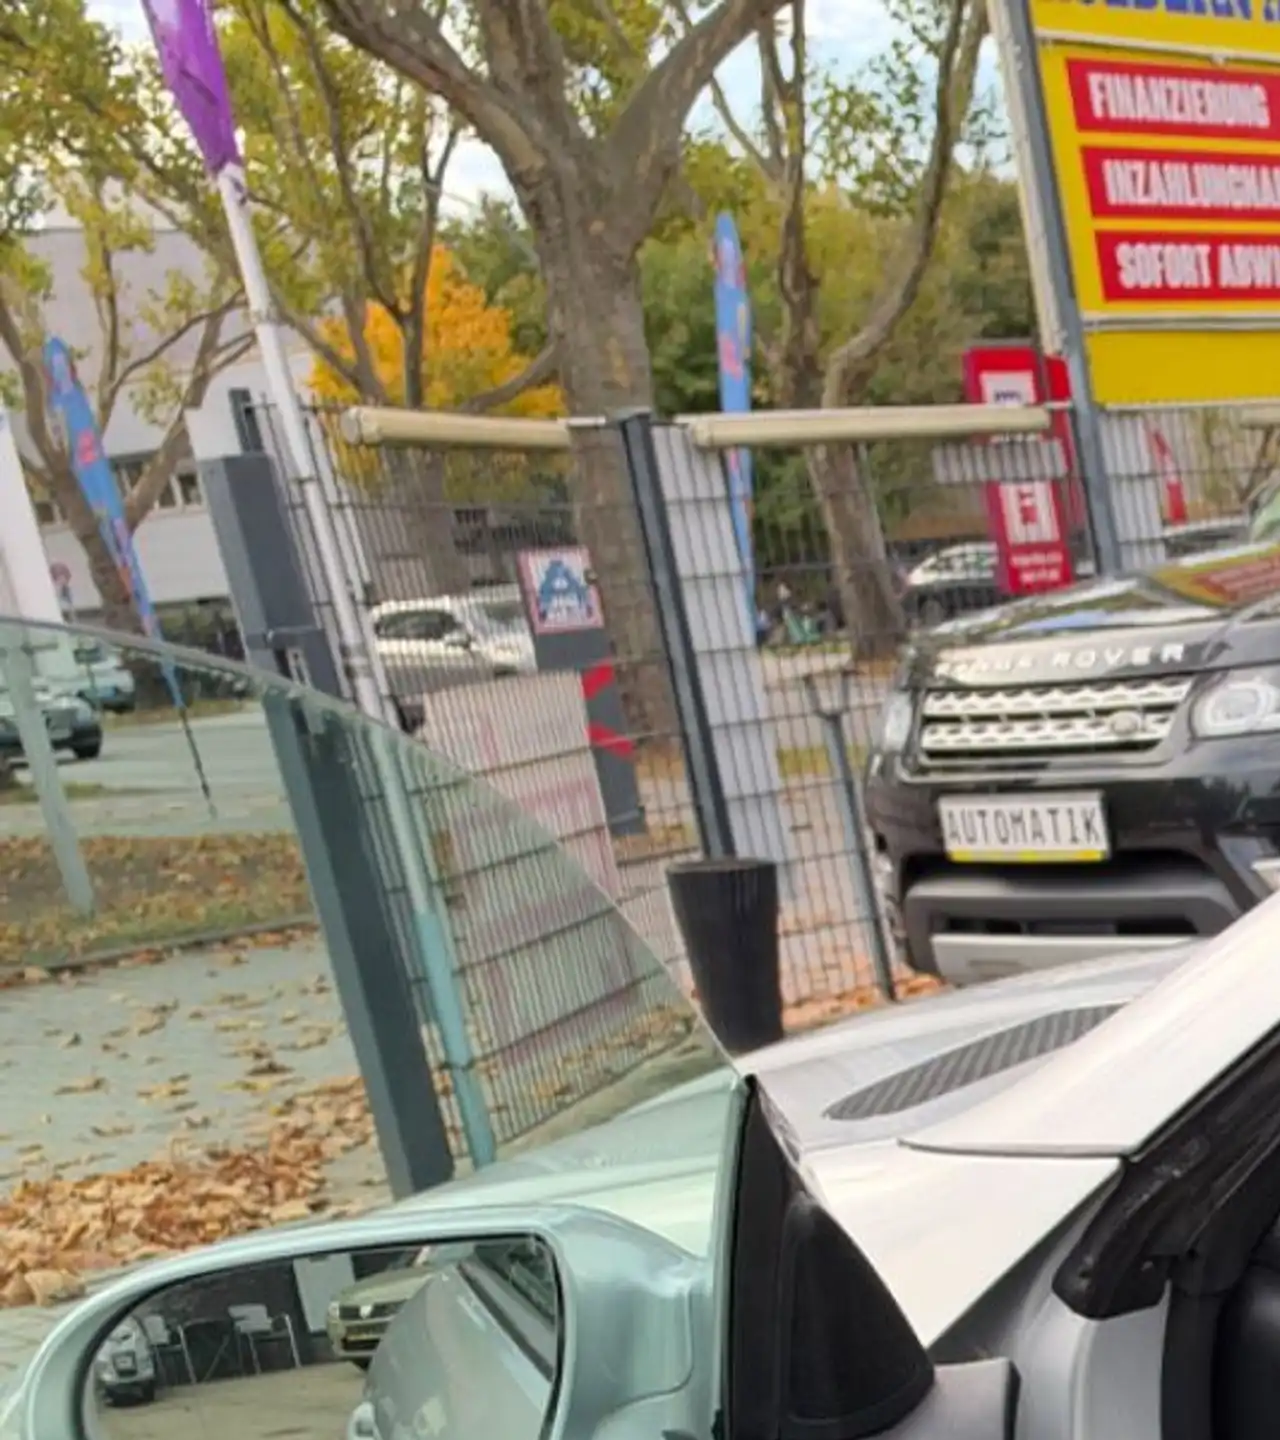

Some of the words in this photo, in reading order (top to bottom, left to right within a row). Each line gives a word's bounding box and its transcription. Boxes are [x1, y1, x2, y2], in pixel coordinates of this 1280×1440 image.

[1087, 72, 1271, 128] FINANZIERUNG
[1115, 242, 1212, 289] SOFORT
[1052, 642, 1185, 670] ROVER
[947, 806, 1101, 846] AUTOMATIK
